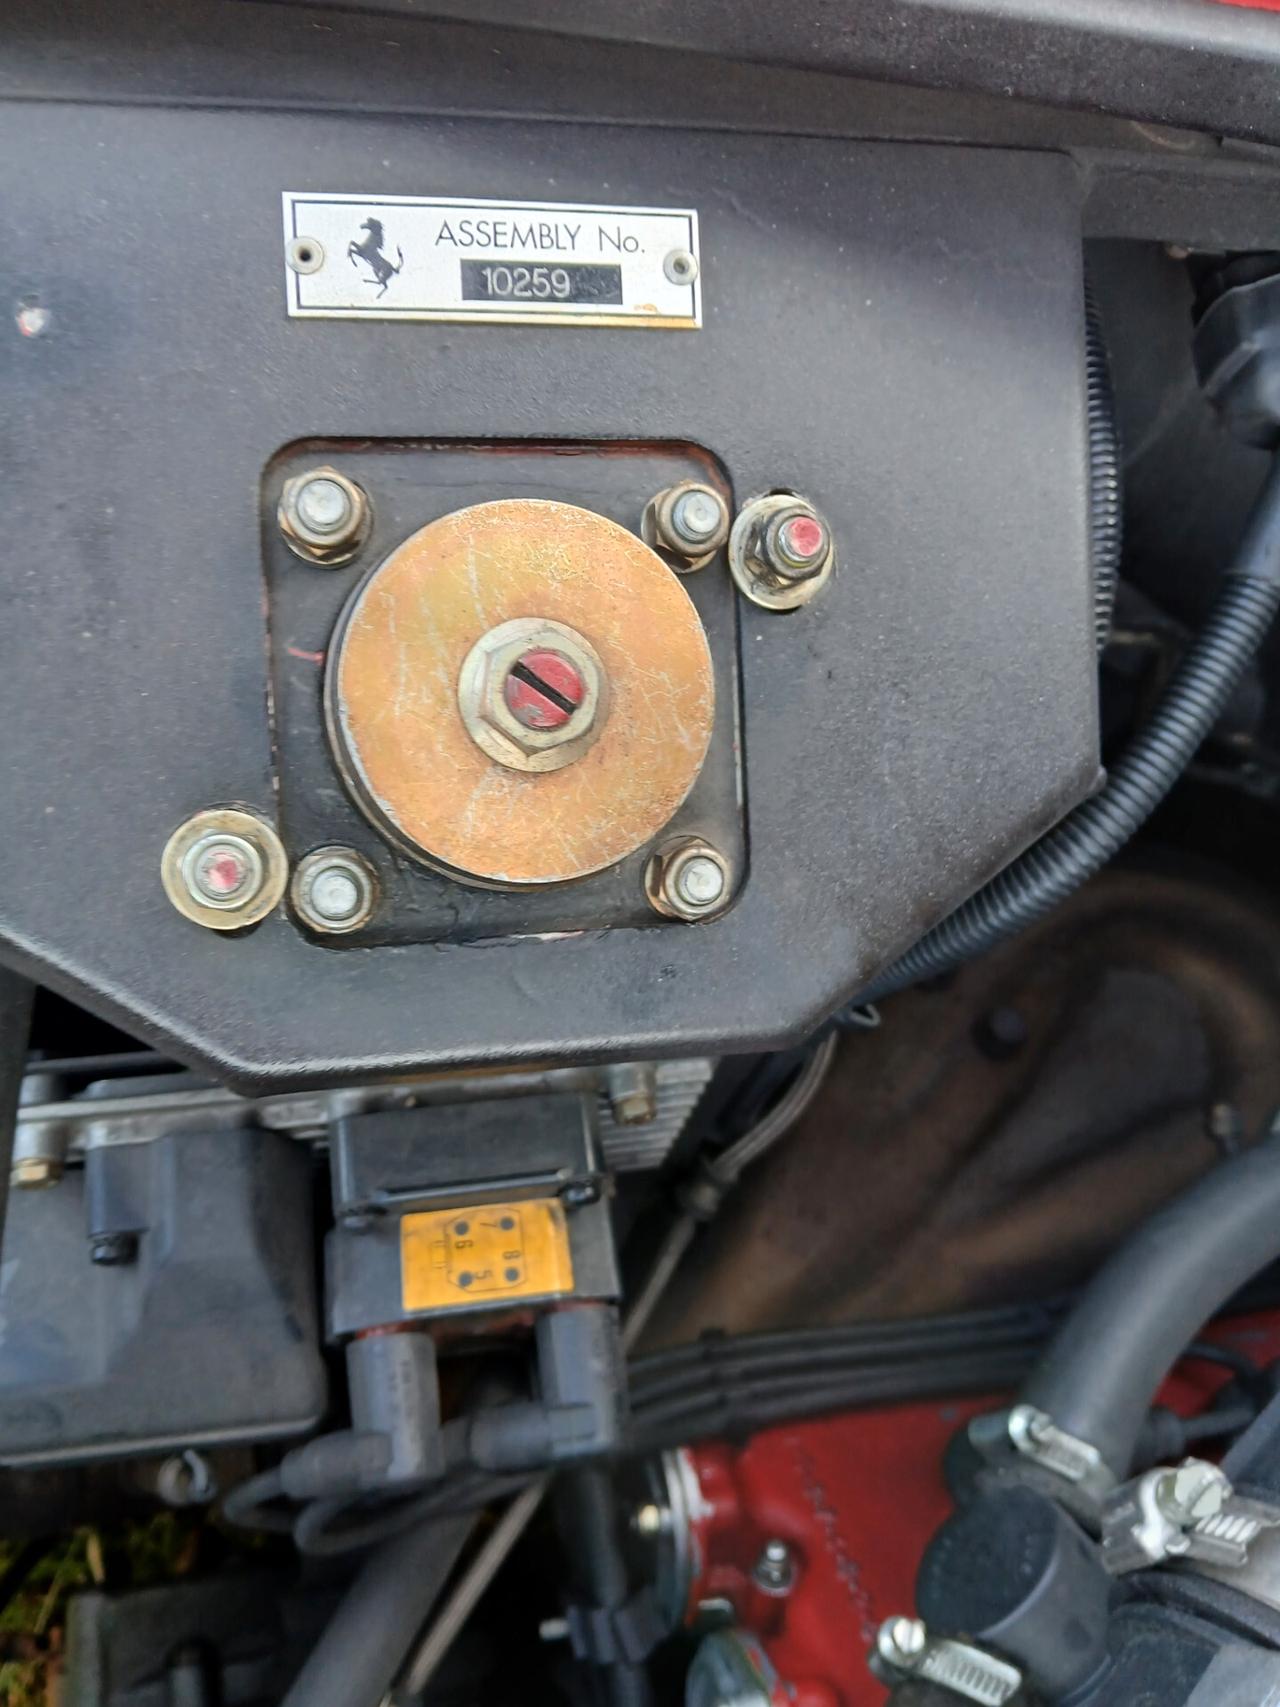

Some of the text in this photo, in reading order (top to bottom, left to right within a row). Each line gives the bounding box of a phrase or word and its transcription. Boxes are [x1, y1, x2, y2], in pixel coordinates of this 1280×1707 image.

[435, 219, 645, 253] ASSEMBLY No.
[481, 266, 571, 298] 10259
[503, 1250, 521, 1260] 8
